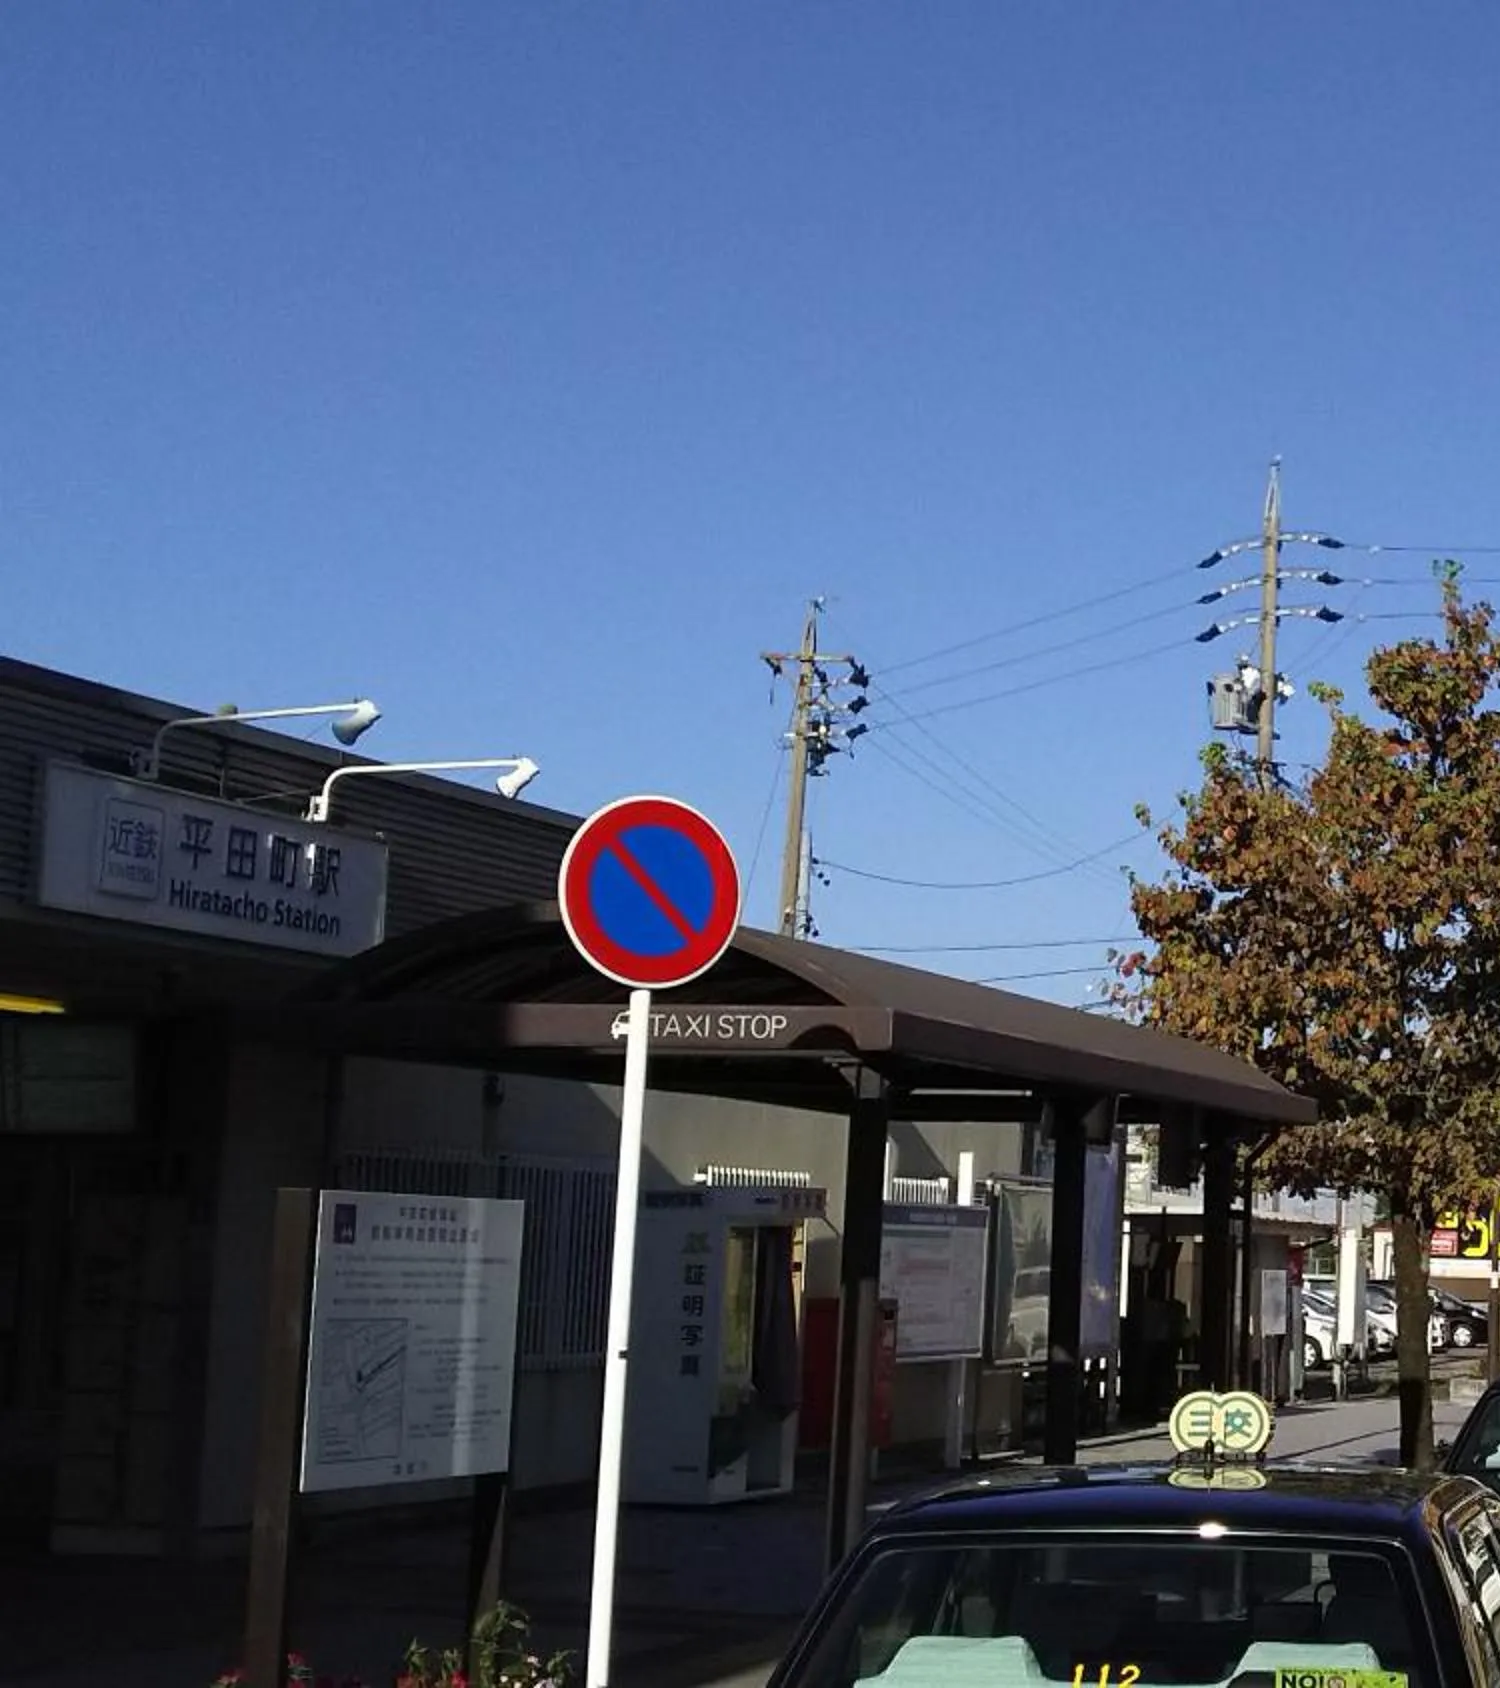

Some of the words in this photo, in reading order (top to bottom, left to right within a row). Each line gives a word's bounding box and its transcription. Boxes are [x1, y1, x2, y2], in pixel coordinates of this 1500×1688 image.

[109, 816, 159, 860] 近鉄
[179, 813, 342, 898] 平田町駅
[168, 878, 268, 923] Hiratacho
[273, 898, 341, 936] Station
[649, 1012, 711, 1038] TAXI
[717, 1014, 788, 1039] STOP
